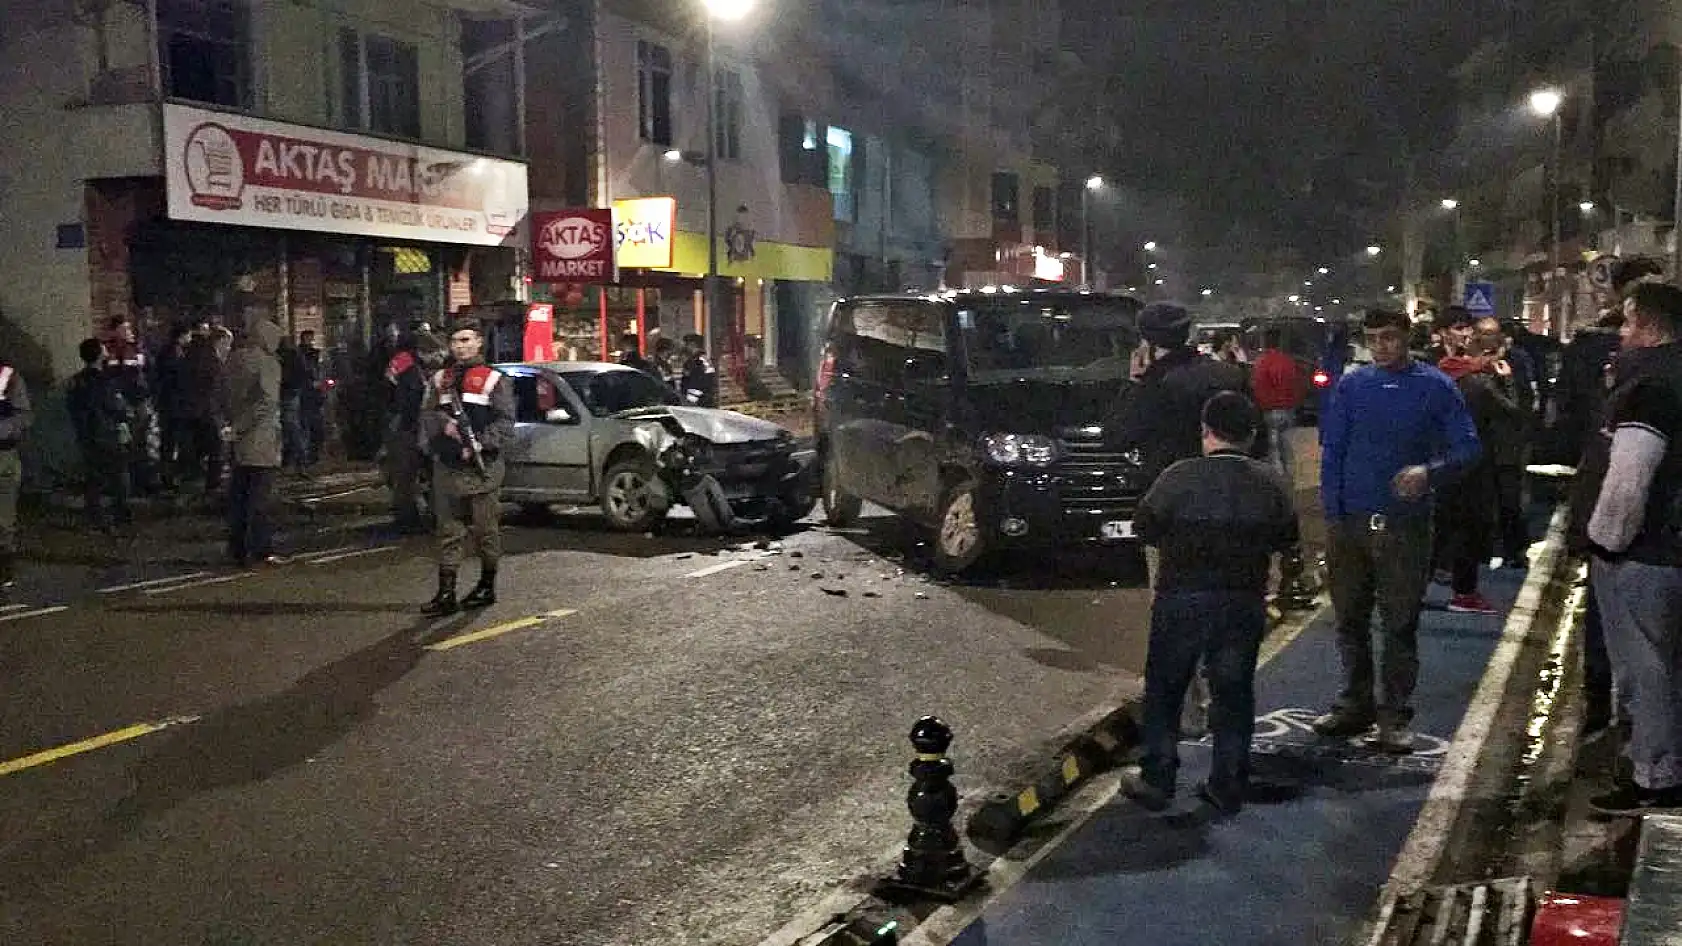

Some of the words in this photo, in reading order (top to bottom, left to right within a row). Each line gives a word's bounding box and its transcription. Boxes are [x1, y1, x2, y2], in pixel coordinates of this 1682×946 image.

[254, 139, 356, 194] AKTAŞ
[253, 194, 281, 214] HER
[538, 224, 605, 250] AKTAŞ
[540, 259, 606, 277] MARKET
